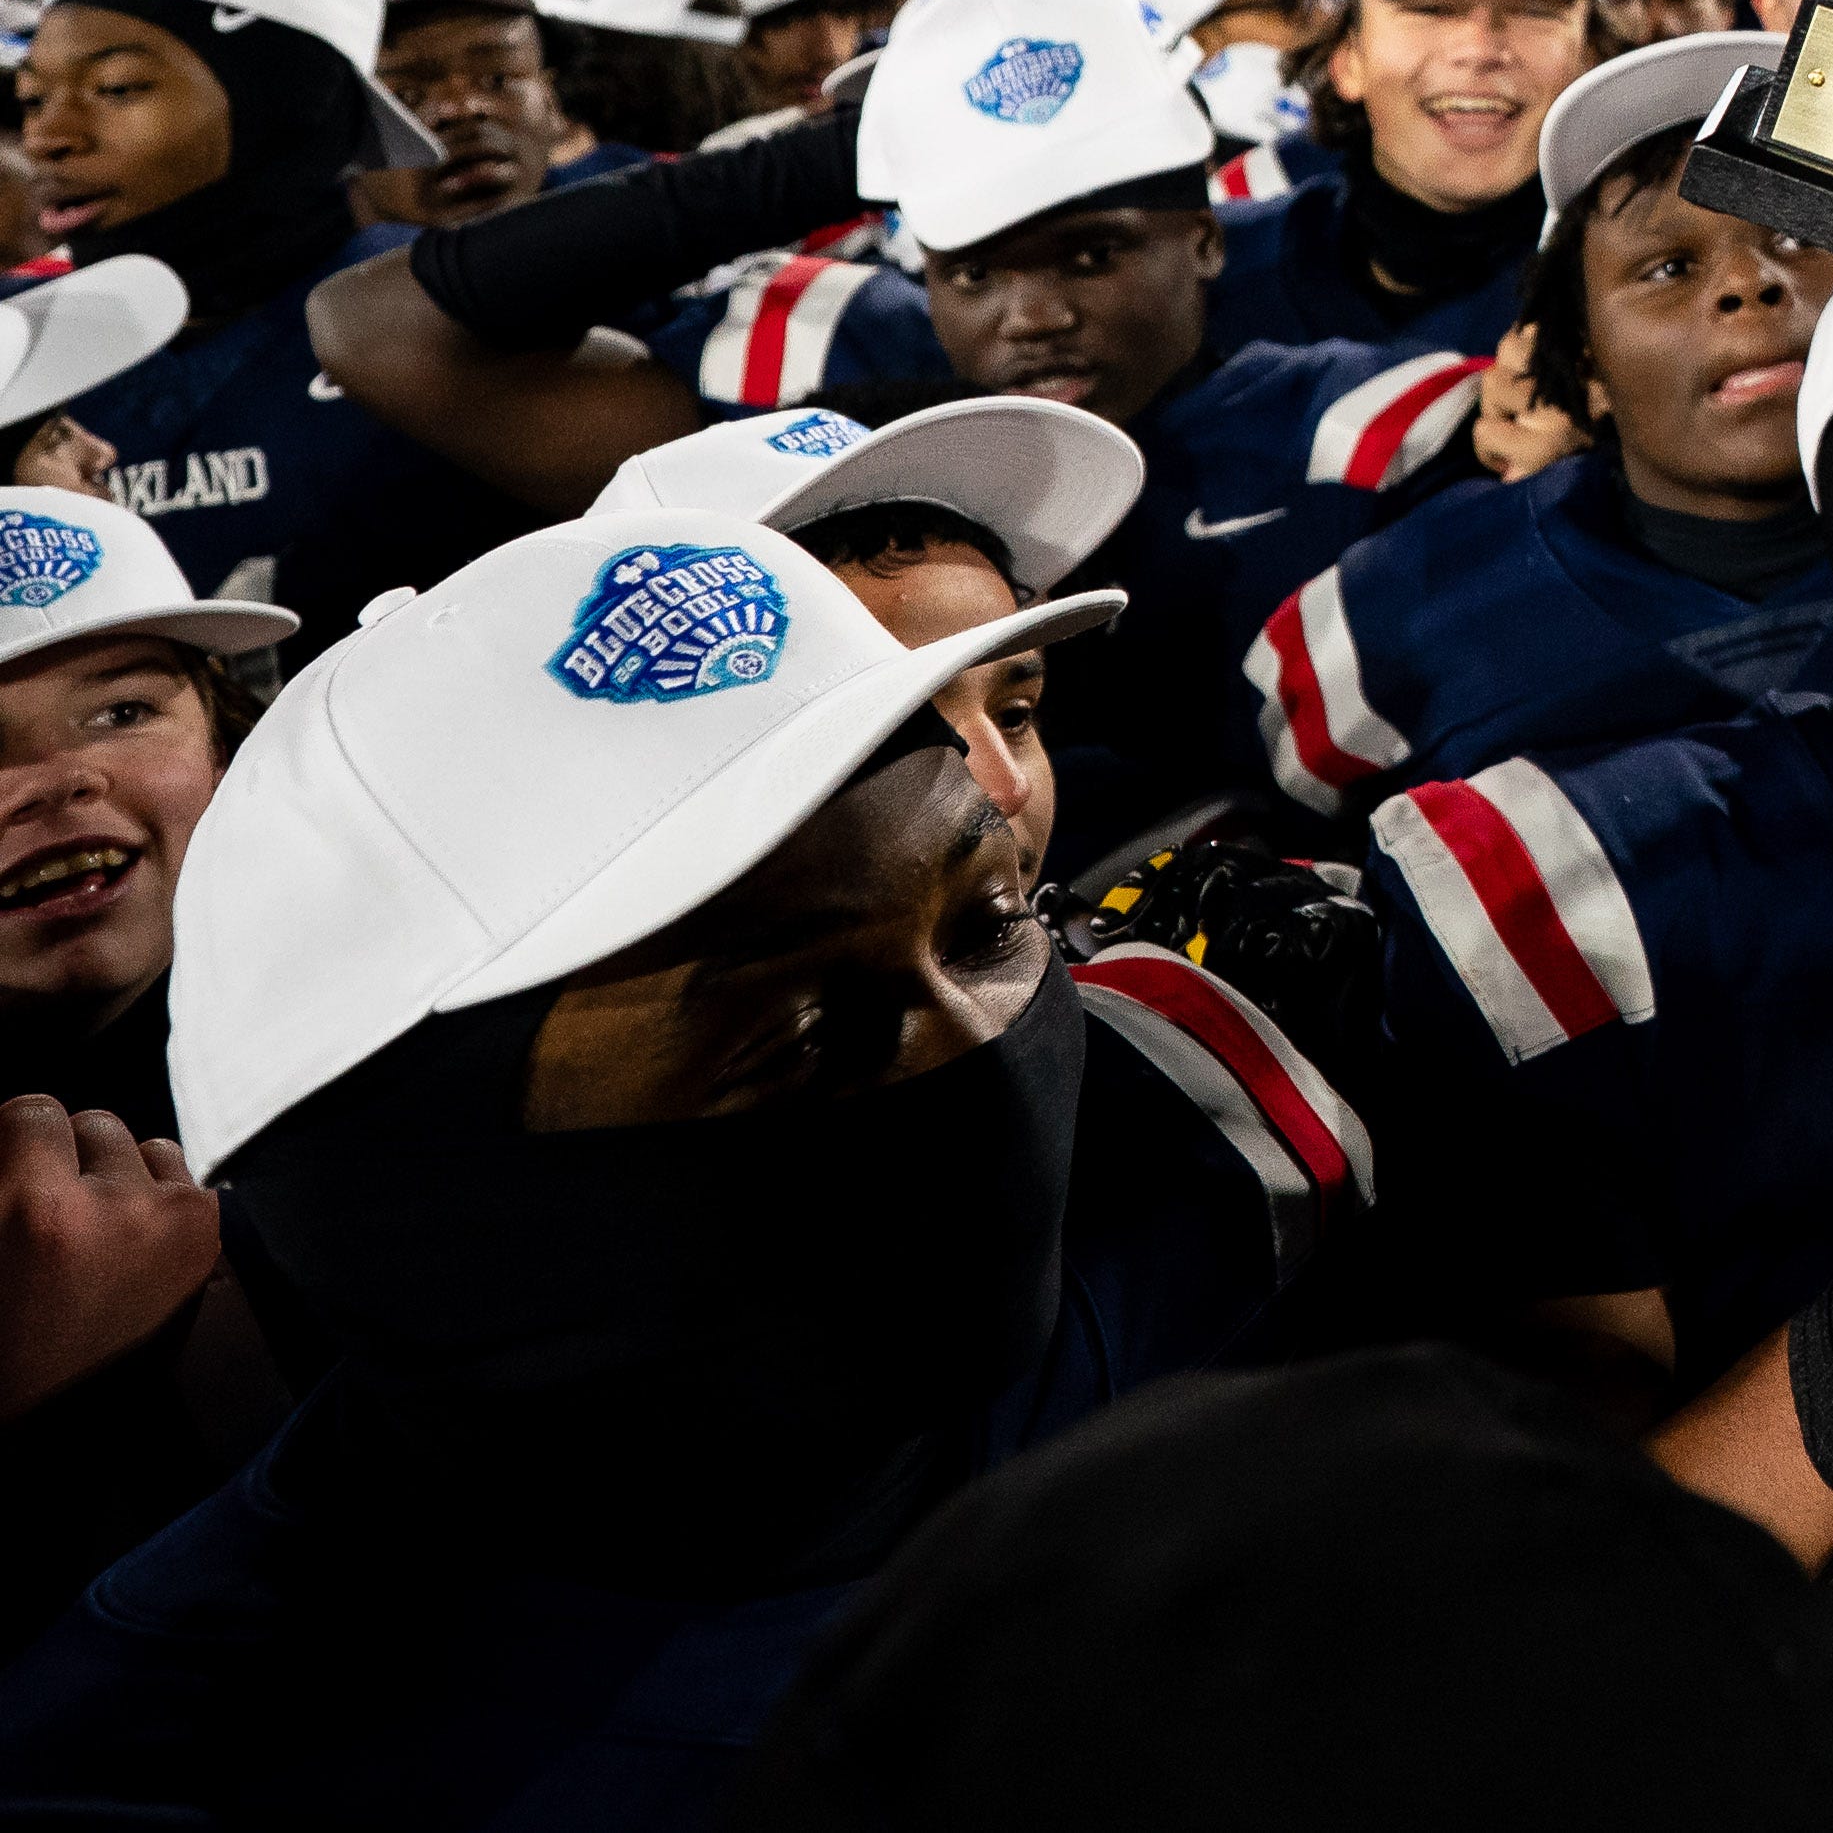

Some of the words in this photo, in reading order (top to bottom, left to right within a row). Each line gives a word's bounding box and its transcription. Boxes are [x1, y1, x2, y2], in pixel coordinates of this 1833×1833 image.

[107, 446, 269, 516] AKLAND
[563, 554, 764, 690] BLUECROSS
[637, 589, 743, 658] BOWL
